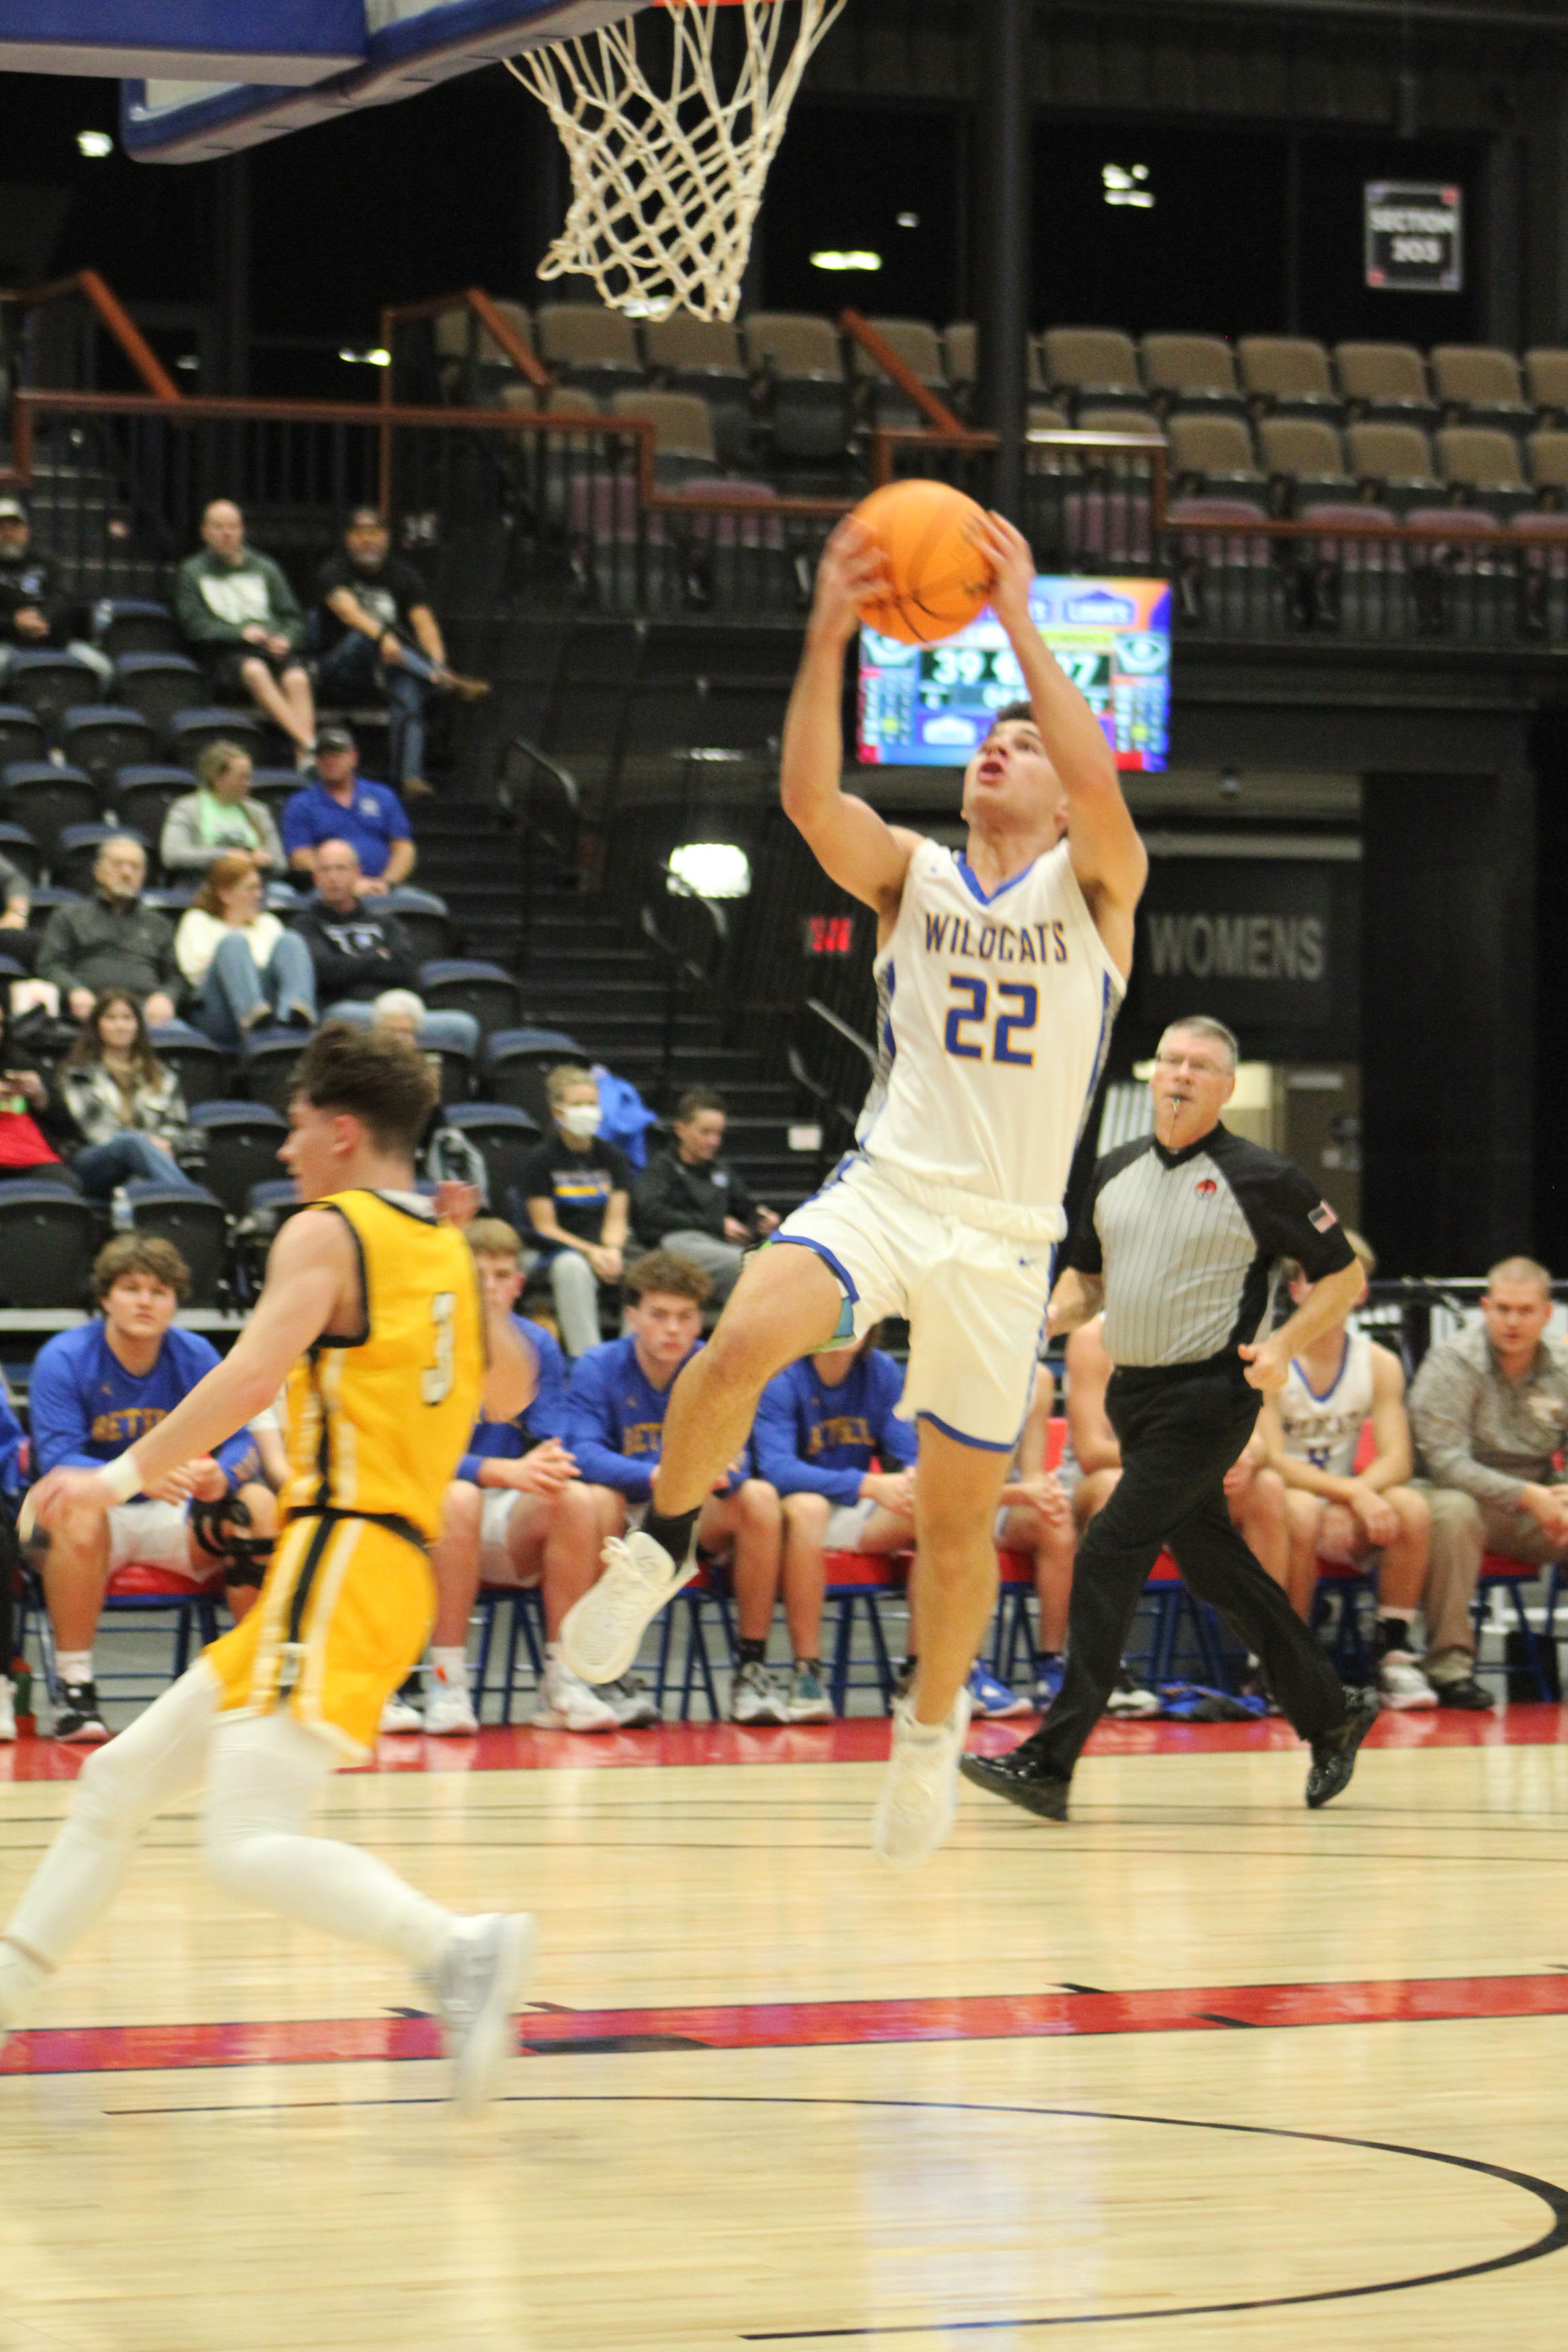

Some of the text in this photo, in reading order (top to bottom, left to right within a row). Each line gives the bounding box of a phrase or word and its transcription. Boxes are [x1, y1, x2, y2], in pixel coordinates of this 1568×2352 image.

[932, 648, 985, 685] 39
[924, 911, 1068, 964] WILDCATS
[1147, 913, 1326, 980] WOMENS
[943, 971, 1039, 1069] 22
[420, 1290, 457, 1407] 3
